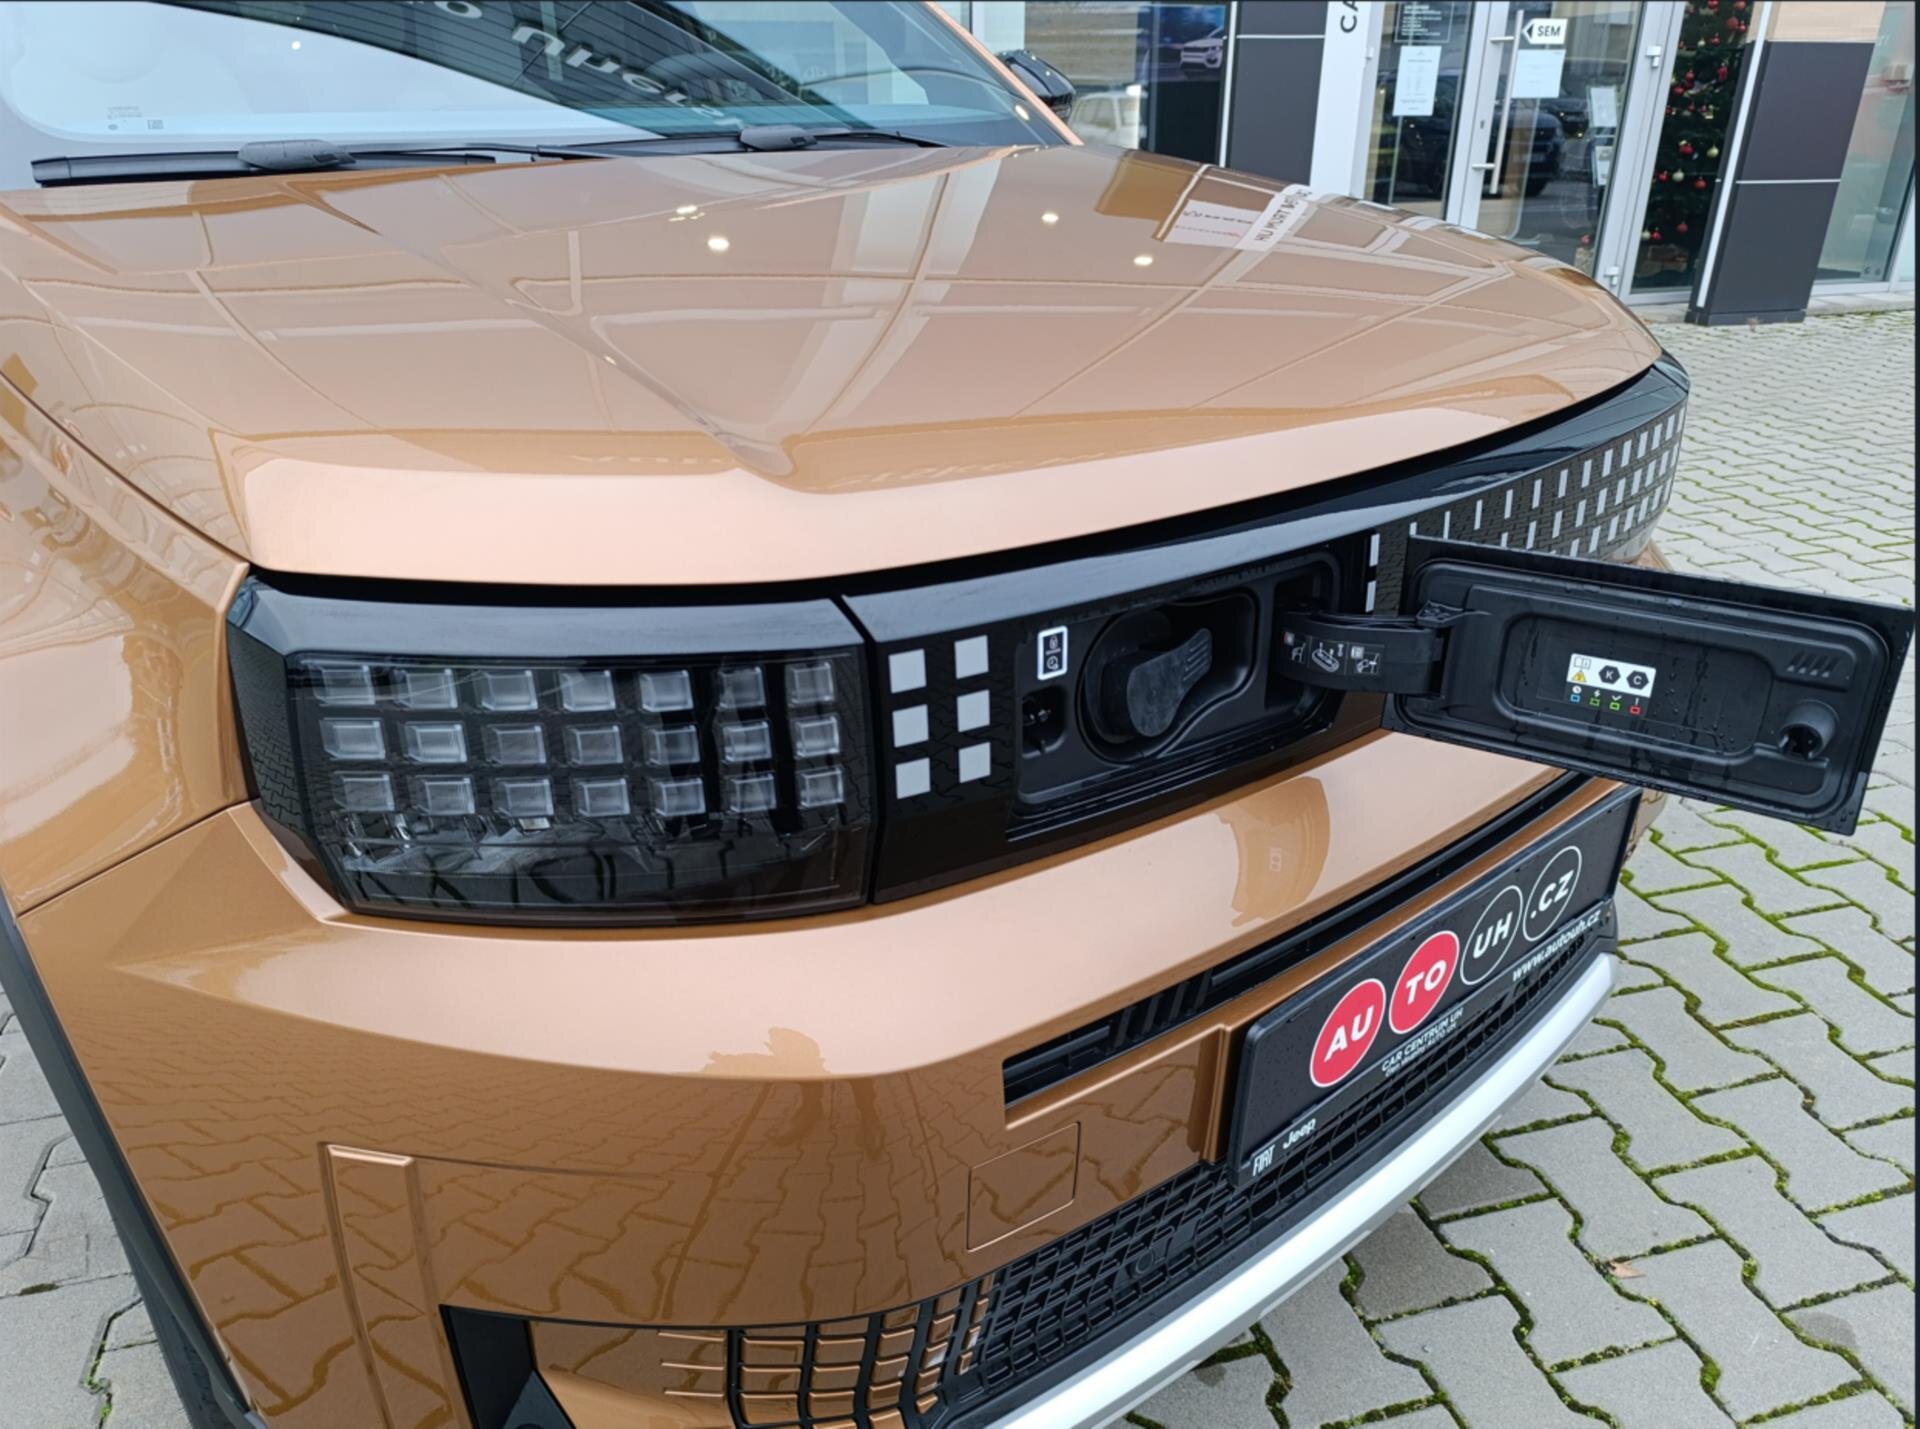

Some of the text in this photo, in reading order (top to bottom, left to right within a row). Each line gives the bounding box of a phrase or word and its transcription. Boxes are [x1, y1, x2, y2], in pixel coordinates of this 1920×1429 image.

[1537, 25, 1561, 37] SEM
[1605, 671, 1641, 684] K C
[1473, 911, 1513, 959] UH
[1530, 870, 1574, 918] .CZ
[1512, 909, 1601, 981] www.autouh.cz
[1381, 1050, 1403, 1072] CAR
[1404, 1018, 1449, 1055] CENTRUM
[1282, 1118, 1316, 1149] Jeep
